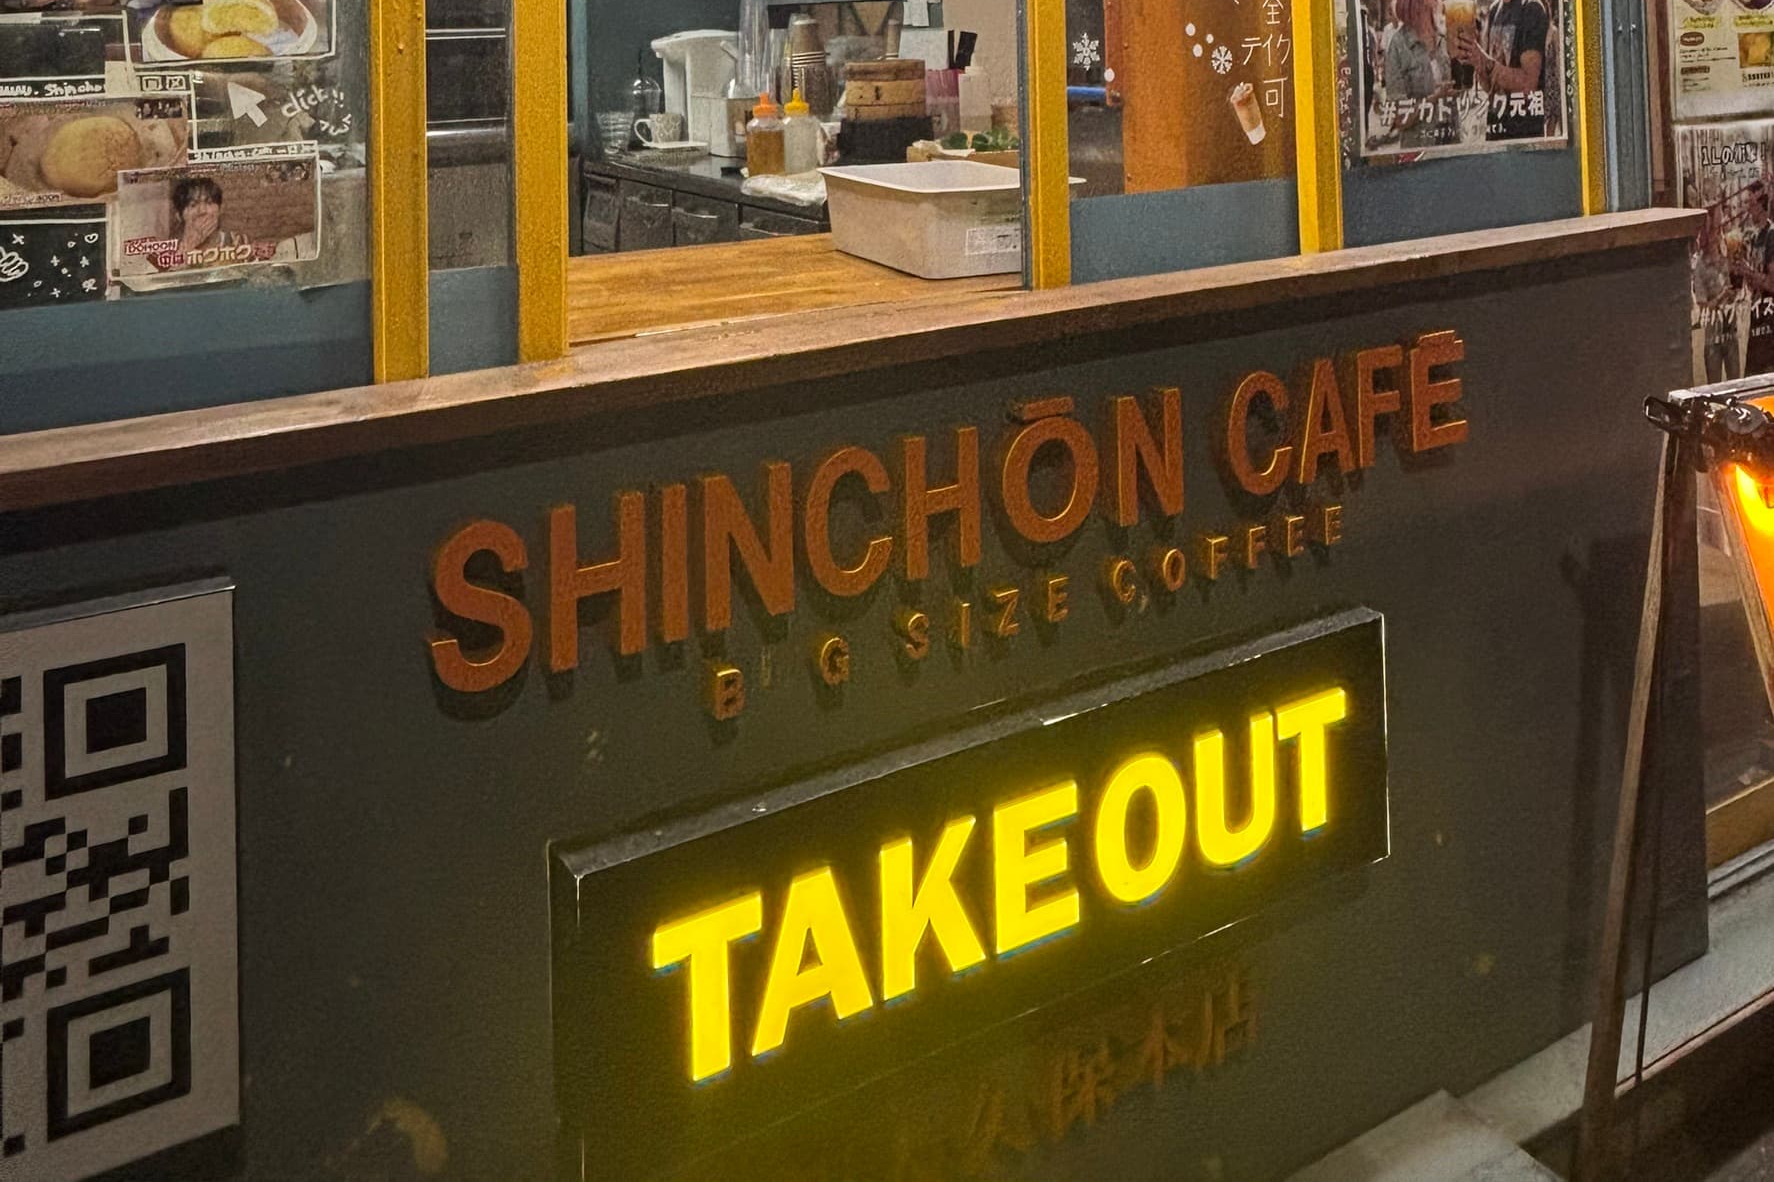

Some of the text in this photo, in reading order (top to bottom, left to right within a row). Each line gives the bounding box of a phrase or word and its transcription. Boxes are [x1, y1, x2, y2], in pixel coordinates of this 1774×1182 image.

[905, 576, 1070, 660] SIZE
[1113, 506, 1343, 603] COFFEE
[651, 685, 1346, 1083] TAKEOUT
